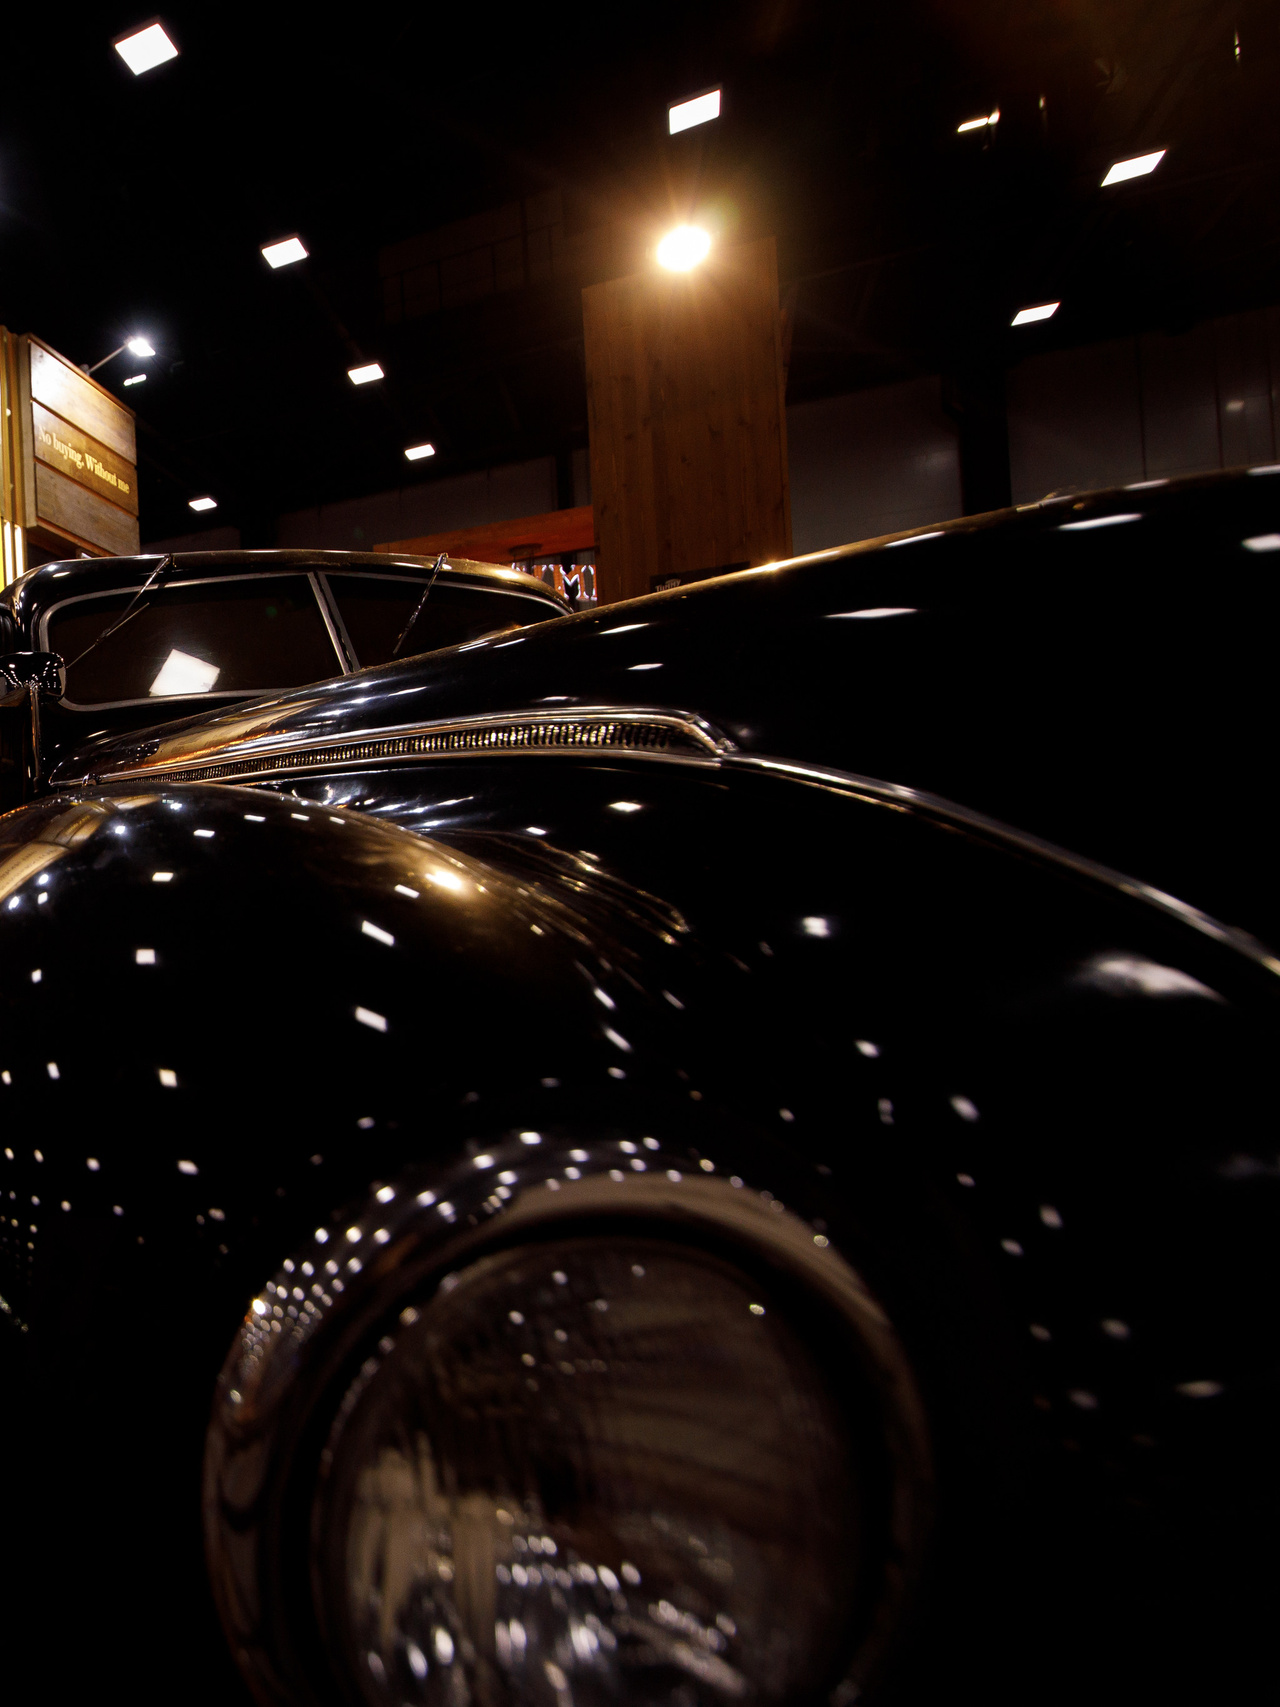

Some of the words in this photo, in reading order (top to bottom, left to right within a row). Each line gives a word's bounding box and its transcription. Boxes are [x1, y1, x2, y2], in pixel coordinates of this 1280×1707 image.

[39, 426, 51, 445] No
[85, 453, 117, 486] Without
[118, 479, 130, 494] me
